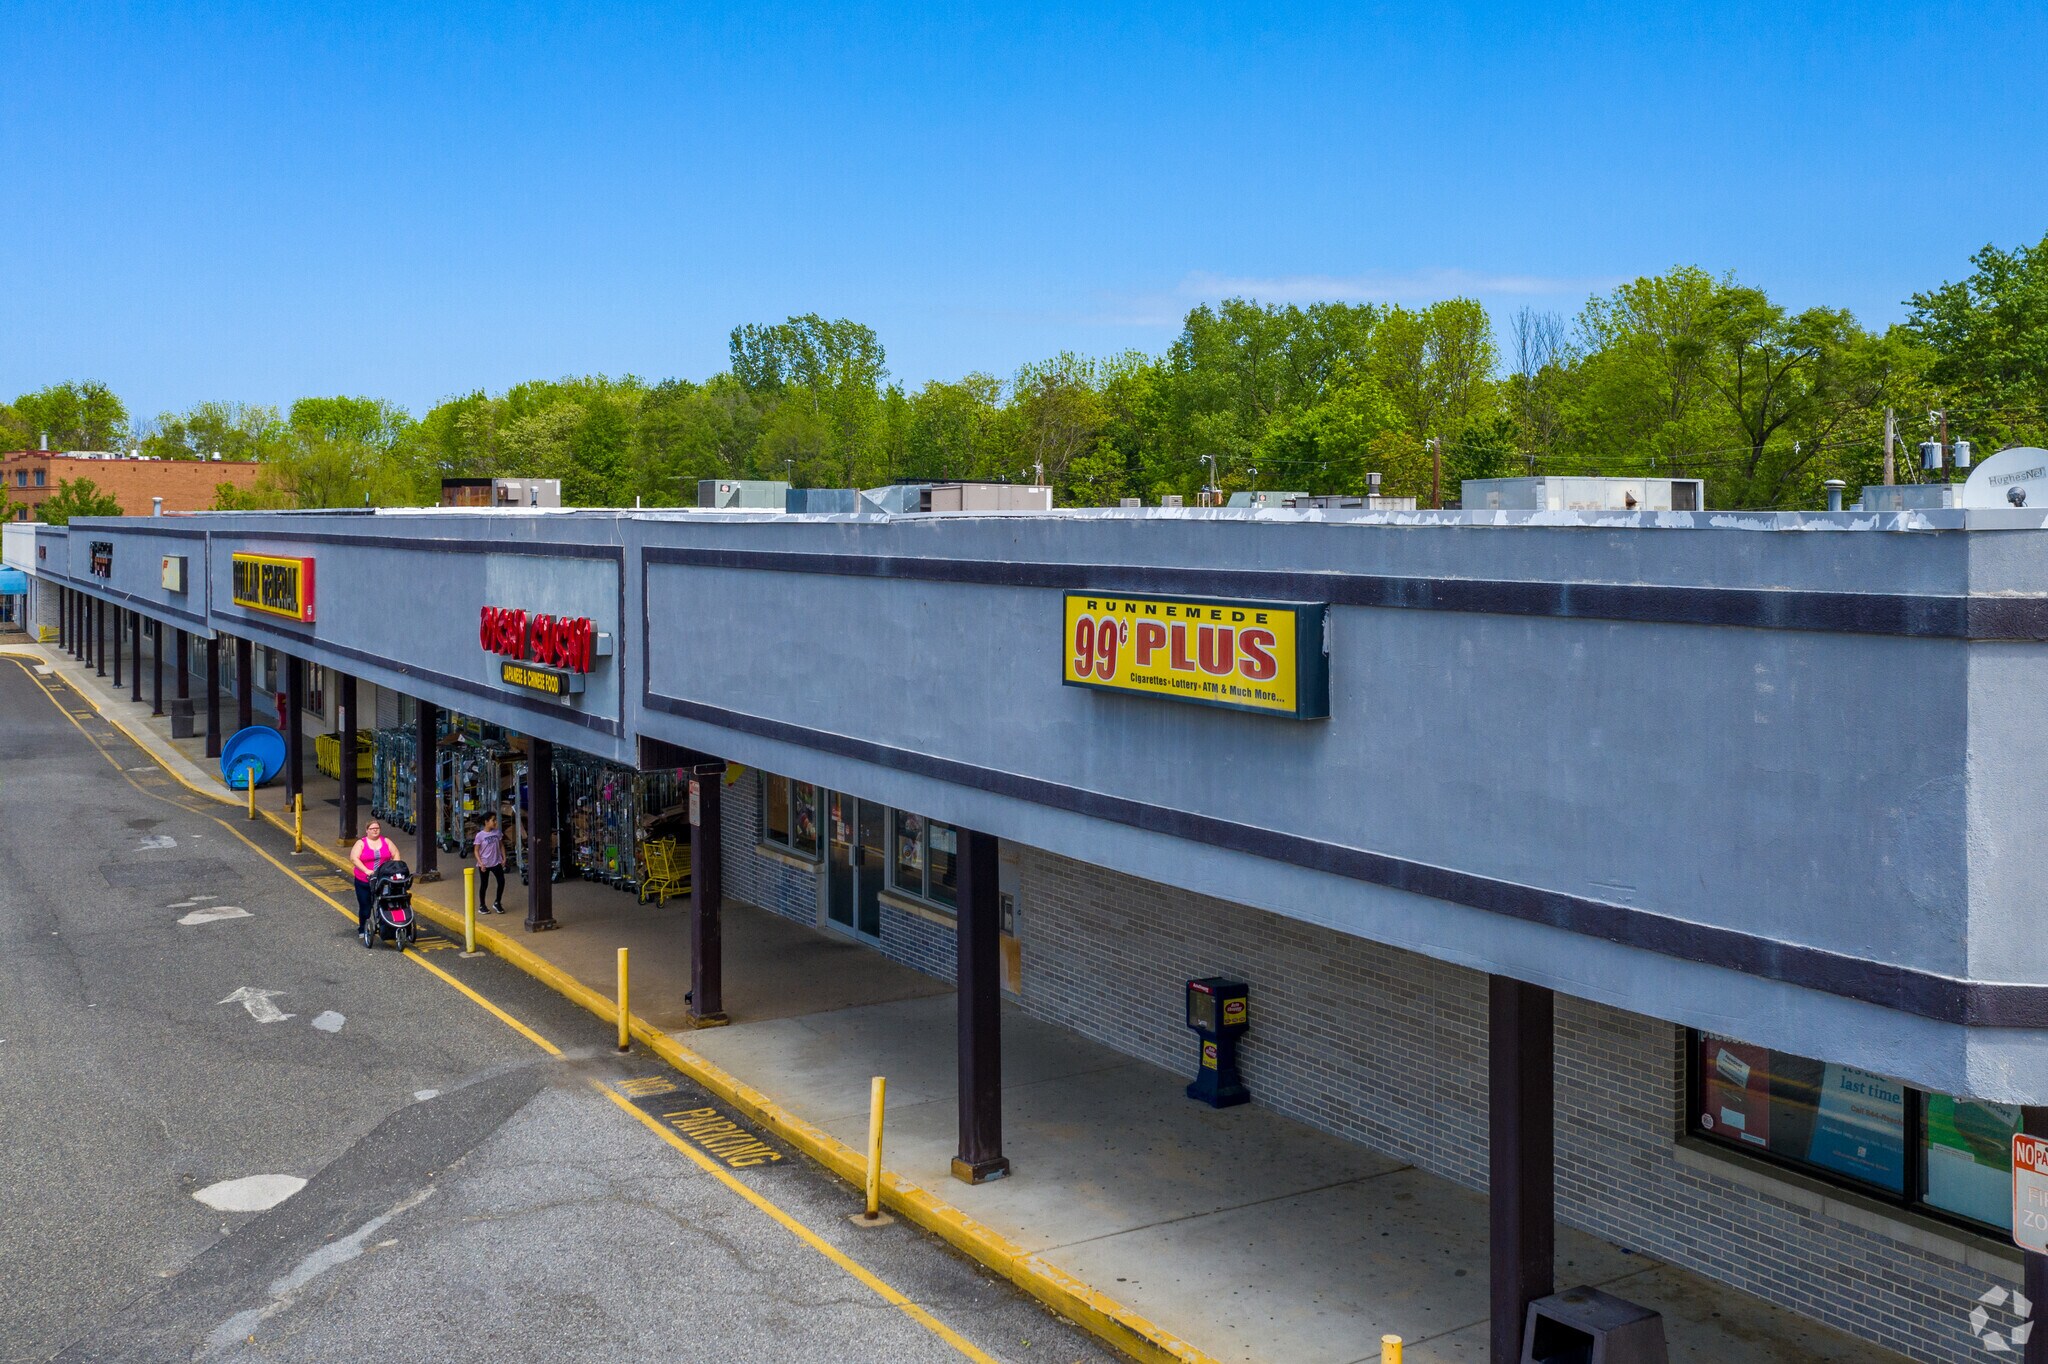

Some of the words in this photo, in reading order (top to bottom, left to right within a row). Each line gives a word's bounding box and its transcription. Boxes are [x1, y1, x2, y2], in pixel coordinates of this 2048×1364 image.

[1087, 600, 1268, 625] RUNNEMEDE
[1135, 617, 1278, 682] PLUS
[503, 664, 523, 685] JAPANESE
[527, 671, 545, 690] CHINESE
[545, 673, 559, 694] FOOD
[1202, 681, 1219, 693] ATM
[1221, 684, 1228, 695] &
[1229, 685, 1252, 698] Much
[1840, 1075, 1865, 1097] last
[662, 1107, 782, 1168] PARKING
[2016, 1141, 2035, 1165] NO
